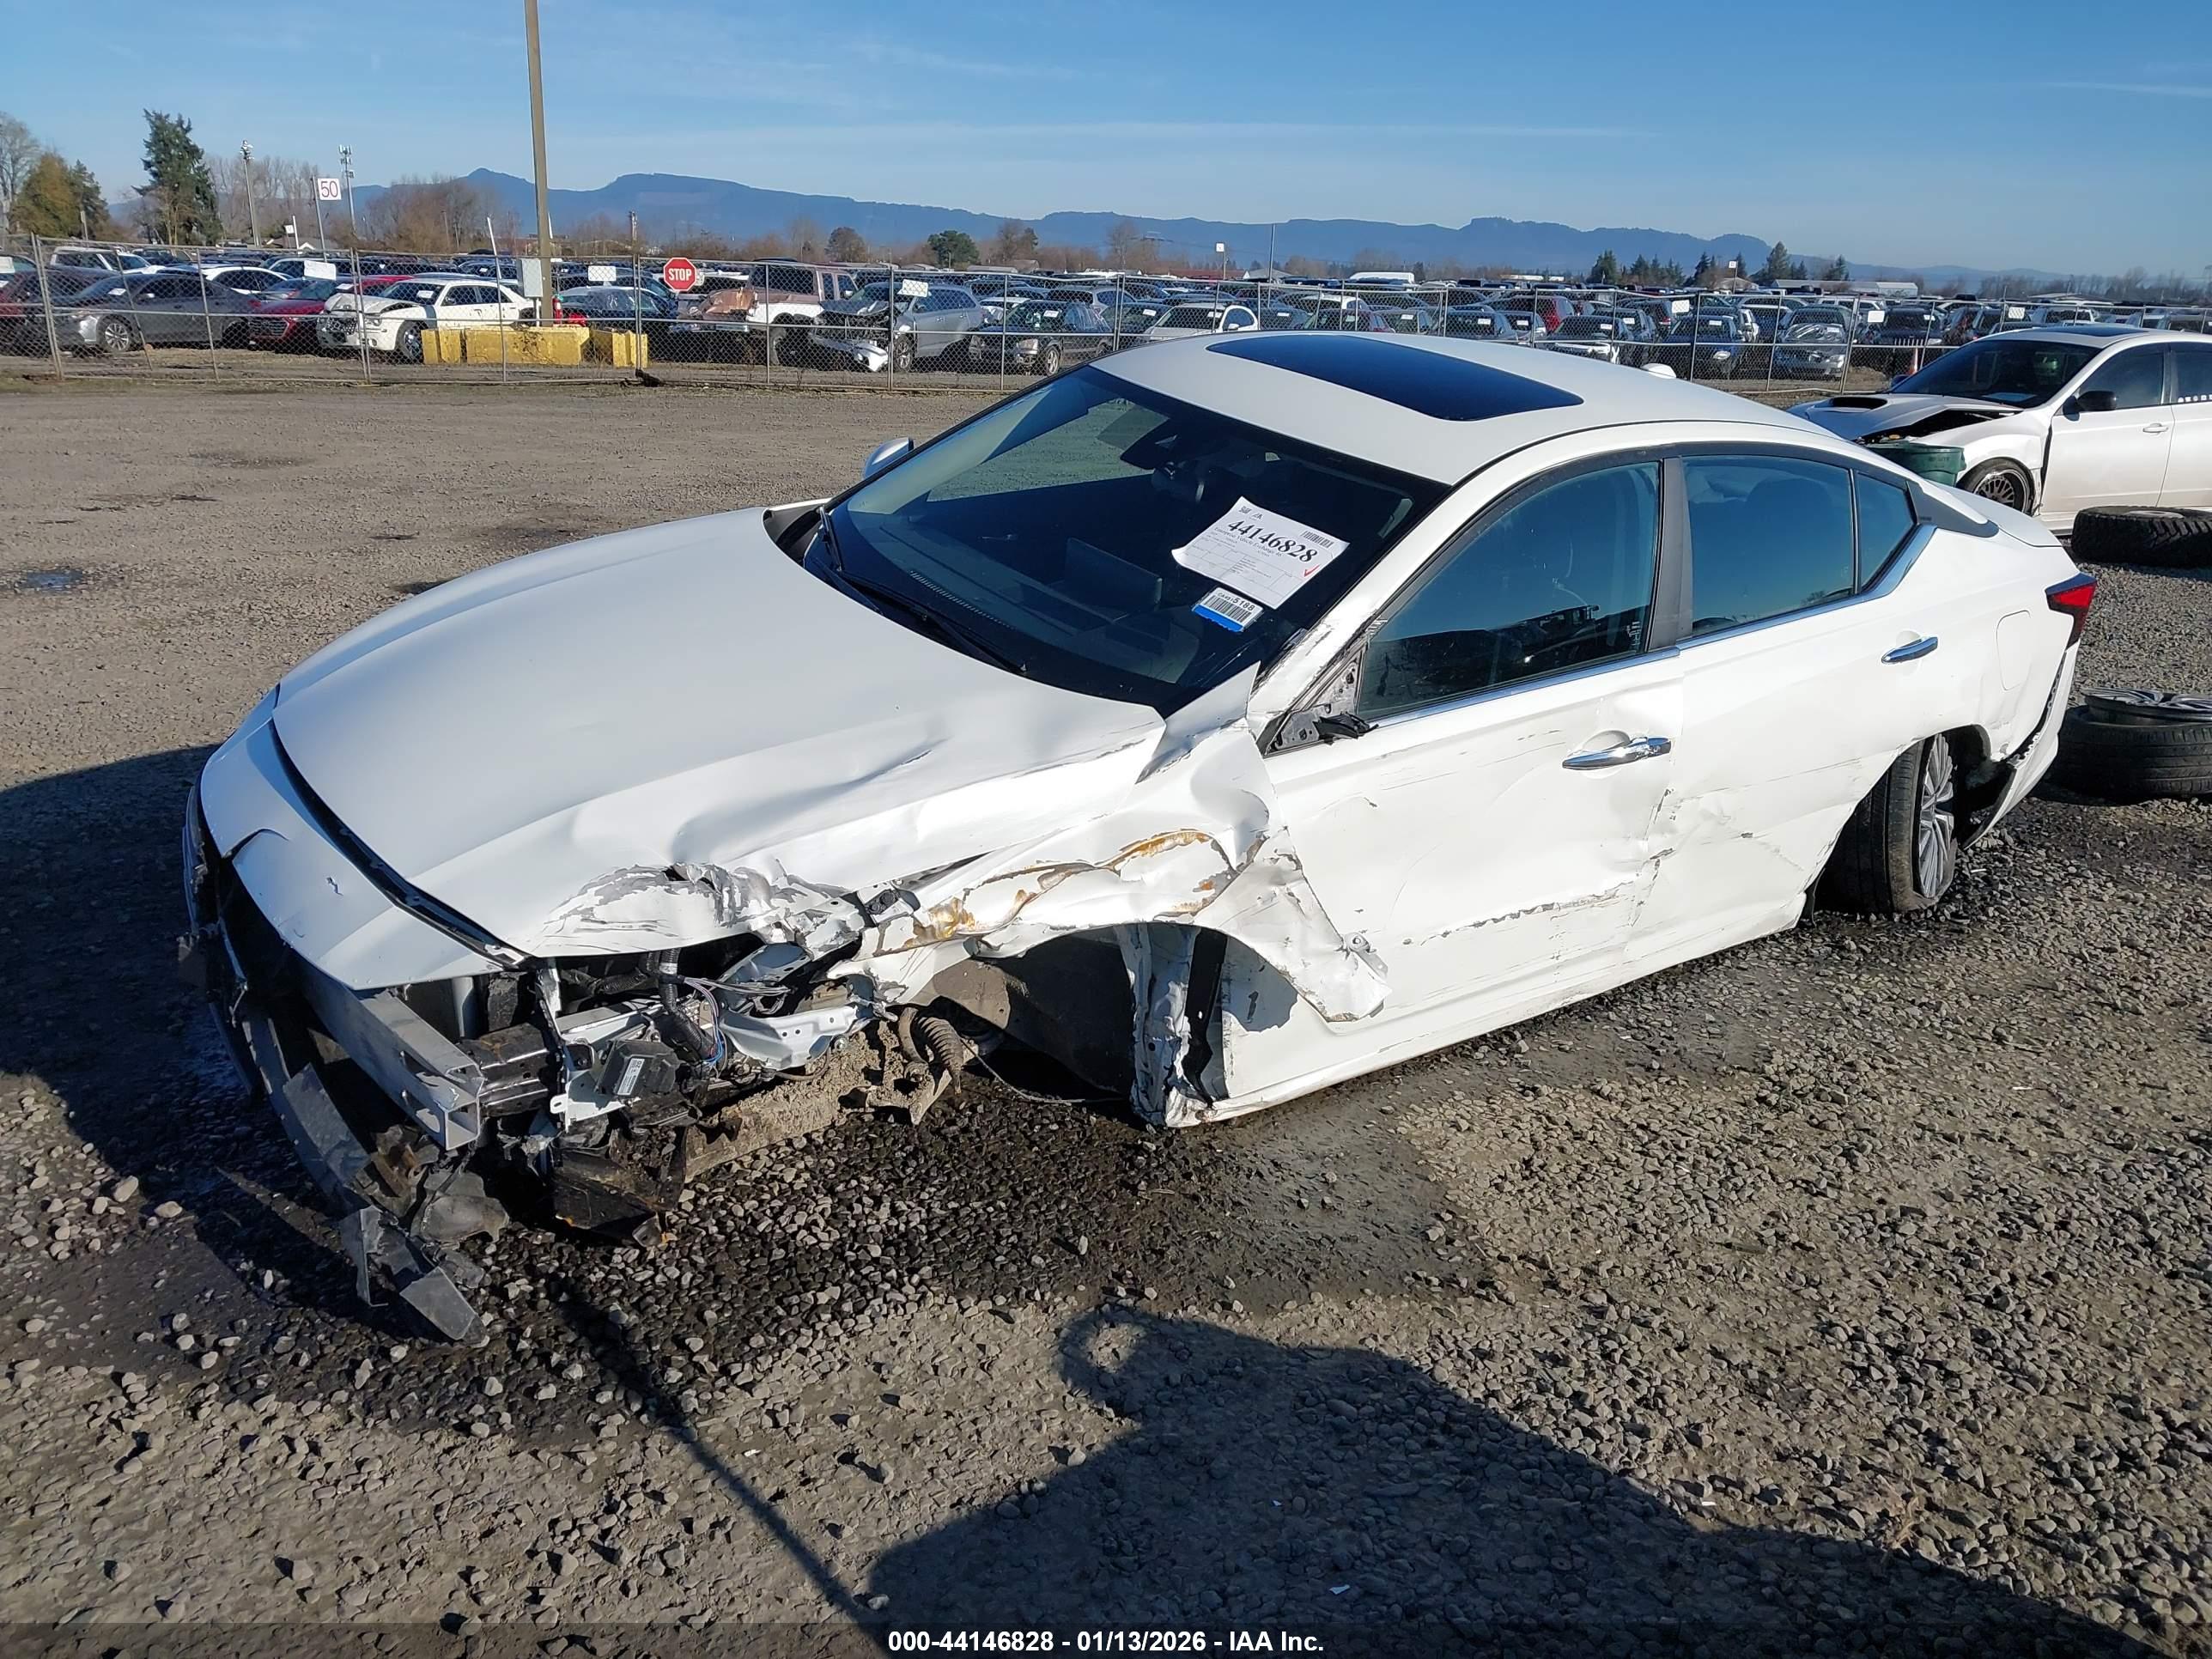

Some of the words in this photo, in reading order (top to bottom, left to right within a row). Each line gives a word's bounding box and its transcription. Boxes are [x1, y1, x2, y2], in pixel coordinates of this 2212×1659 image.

[321, 180, 338, 198] 50
[668, 268, 692, 282] STOP
[1228, 520, 1318, 562] 44146828
